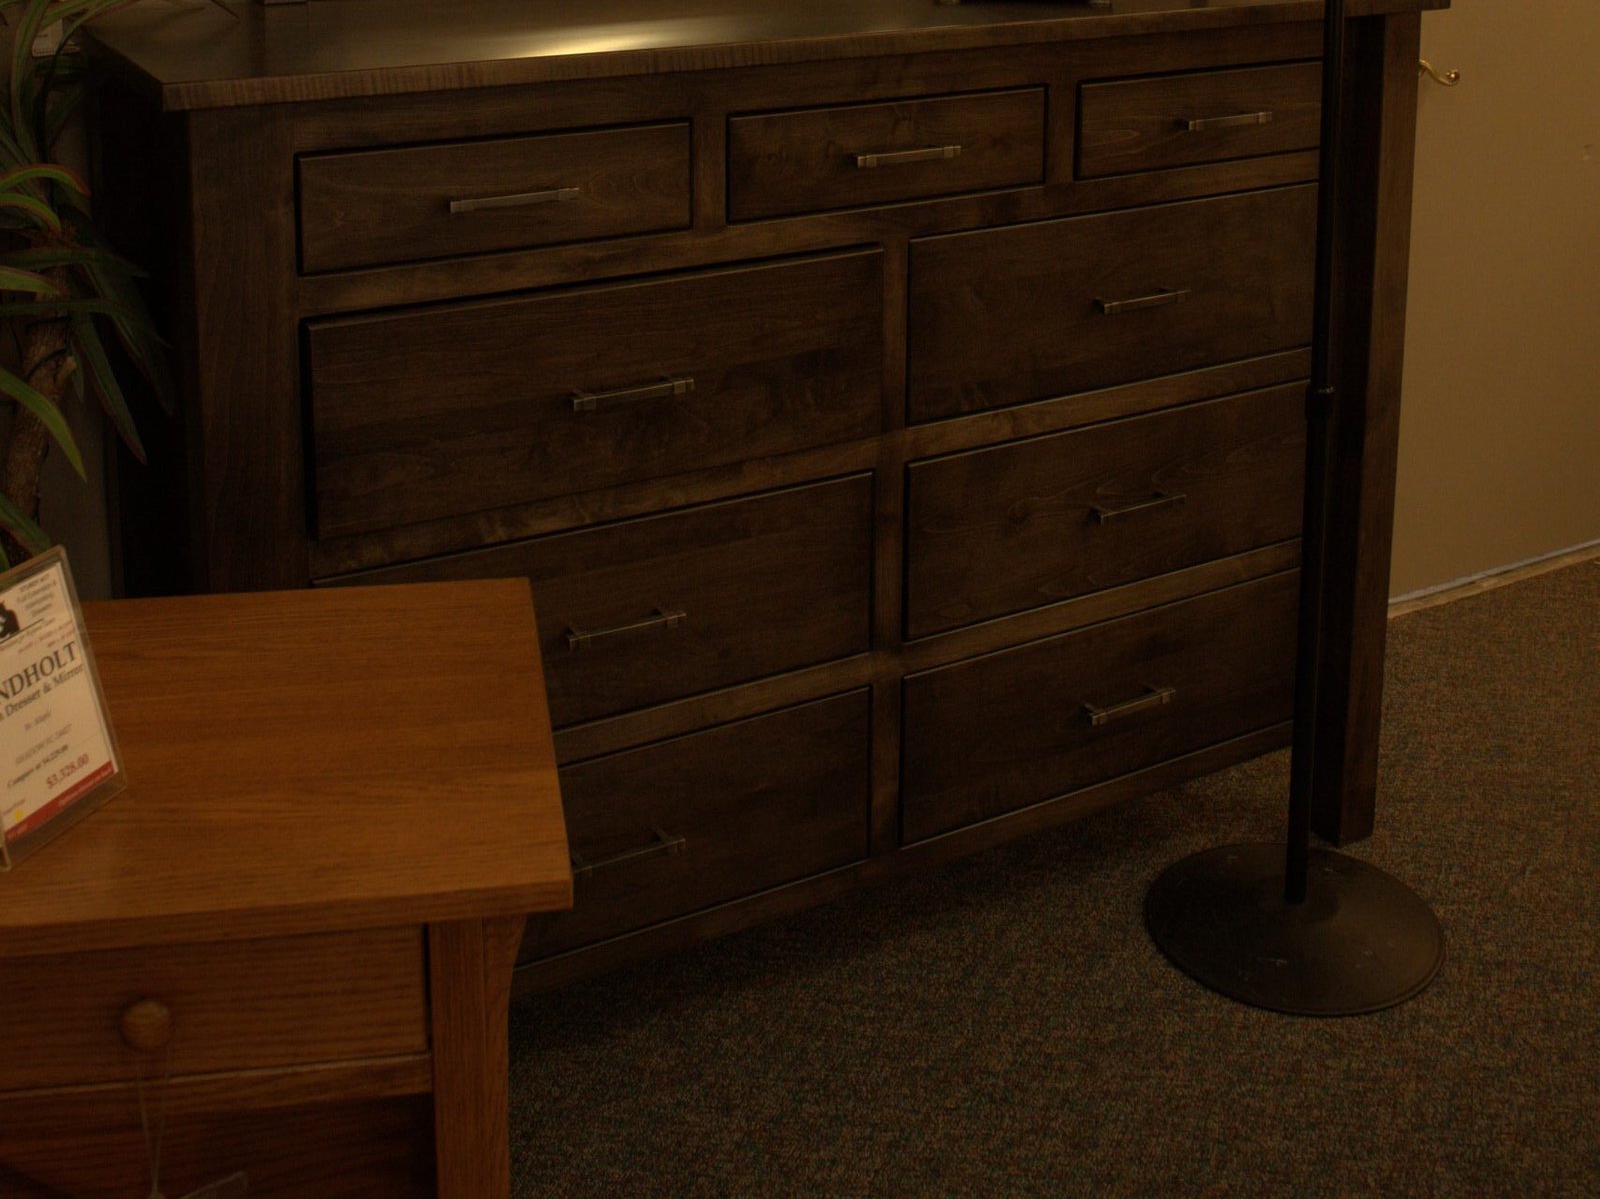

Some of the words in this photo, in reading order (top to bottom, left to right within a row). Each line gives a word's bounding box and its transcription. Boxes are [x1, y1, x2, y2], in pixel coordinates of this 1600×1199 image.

[5, 689, 41, 717] Dresser
[43, 683, 52, 695] &
[52, 663, 86, 685] Mirror
